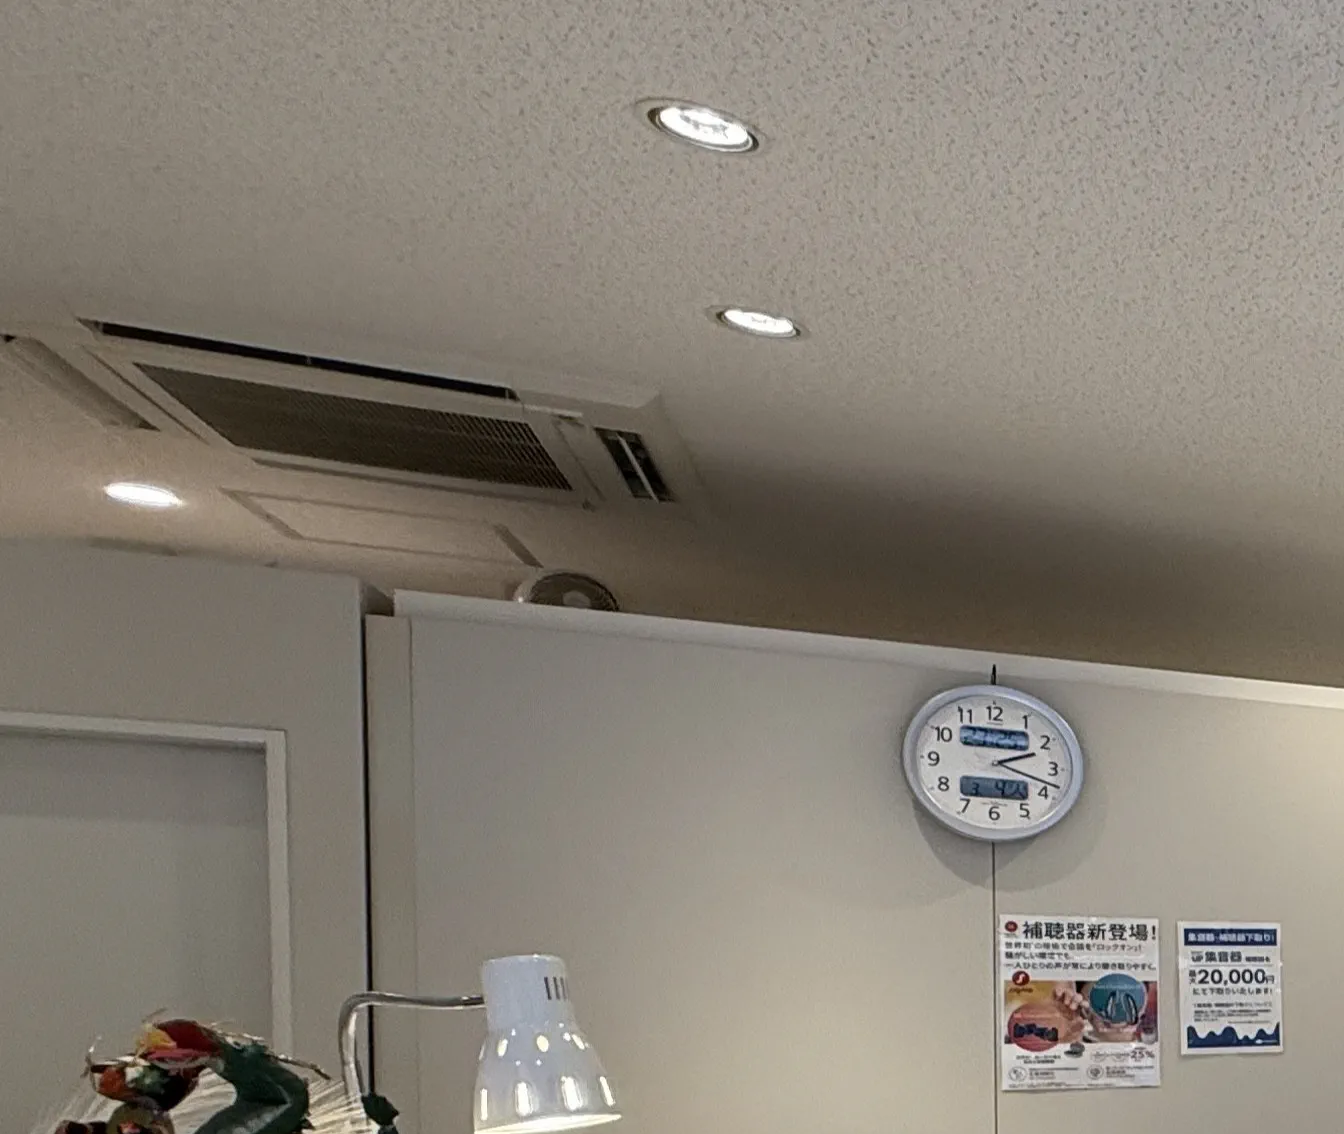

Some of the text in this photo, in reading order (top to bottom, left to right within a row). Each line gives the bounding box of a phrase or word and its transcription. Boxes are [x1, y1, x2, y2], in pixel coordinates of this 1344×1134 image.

[957, 706, 973, 724] 11
[986, 706, 1003, 721] 12
[1022, 715, 1029, 729] 1
[935, 726, 952, 742] 10
[1040, 735, 1051, 750] 2
[927, 751, 940, 766] 9
[1048, 762, 1059, 776] 3
[937, 776, 950, 792] 8
[1038, 786, 1049, 799] 4
[960, 798, 970, 813] 7
[1019, 803, 1030, 818] 5
[989, 806, 1000, 821] 6
[1023, 921, 1157, 941] 補聴器新登場!
